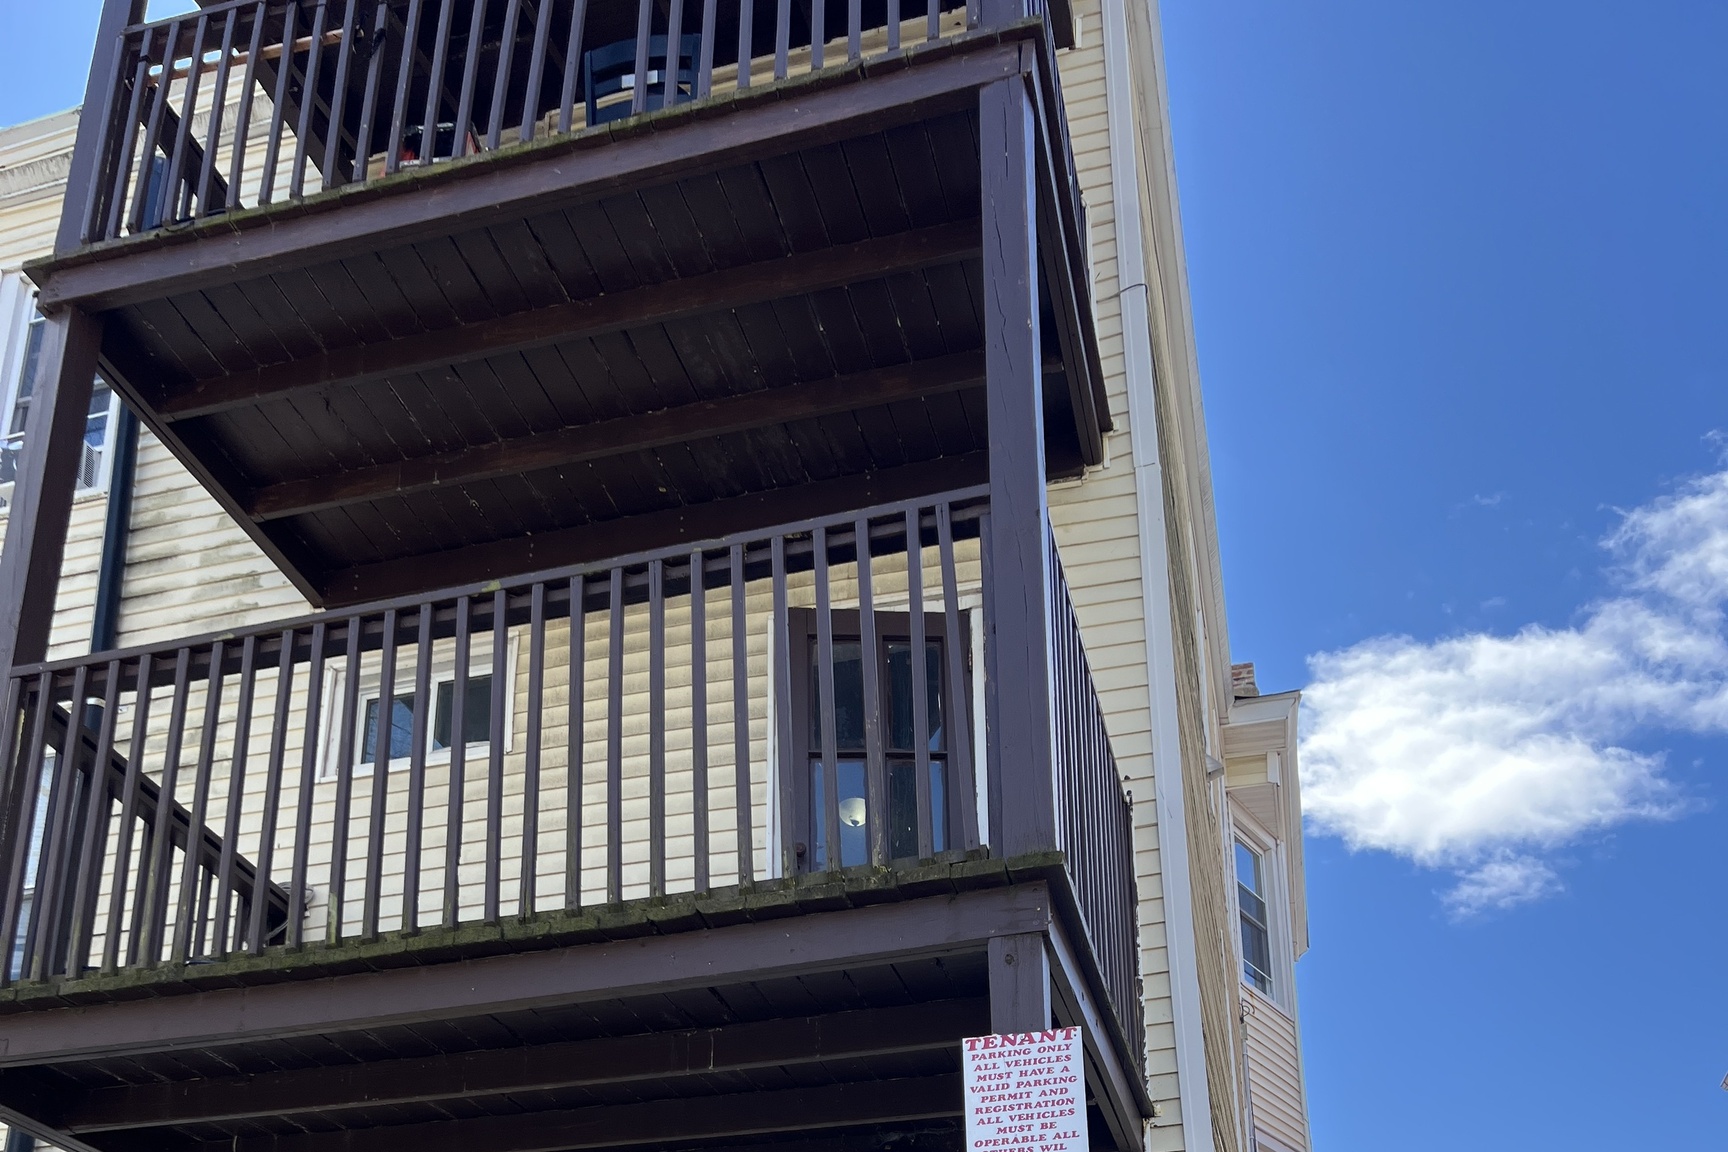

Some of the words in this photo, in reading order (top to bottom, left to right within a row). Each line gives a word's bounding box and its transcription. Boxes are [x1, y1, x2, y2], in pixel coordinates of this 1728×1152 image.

[965, 1027, 1077, 1051] TENANT
[971, 1048, 1031, 1061] PARKING
[1038, 1044, 1072, 1054] ONLY
[974, 1062, 1000, 1072] ALL
[1005, 1055, 1072, 1067] VEHICLES
[976, 1071, 1013, 1082] MUST
[1019, 1067, 1054, 1078] HAVE
[970, 1083, 1010, 1093] VALID
[1016, 1076, 1078, 1088] PARKING
[981, 1092, 1032, 1103] PERMIT
[1039, 1088, 1068, 1097] AND
[975, 1098, 1075, 1114] REGISTRATION
[976, 1117, 1003, 1125] ALL
[1009, 1108, 1075, 1122] VEHICLES
[996, 1124, 1034, 1134] MUST
[1040, 1122, 1057, 1130] BE
[974, 1134, 1047, 1148] OPERABLE
[1053, 1131, 1080, 1139] ALL
